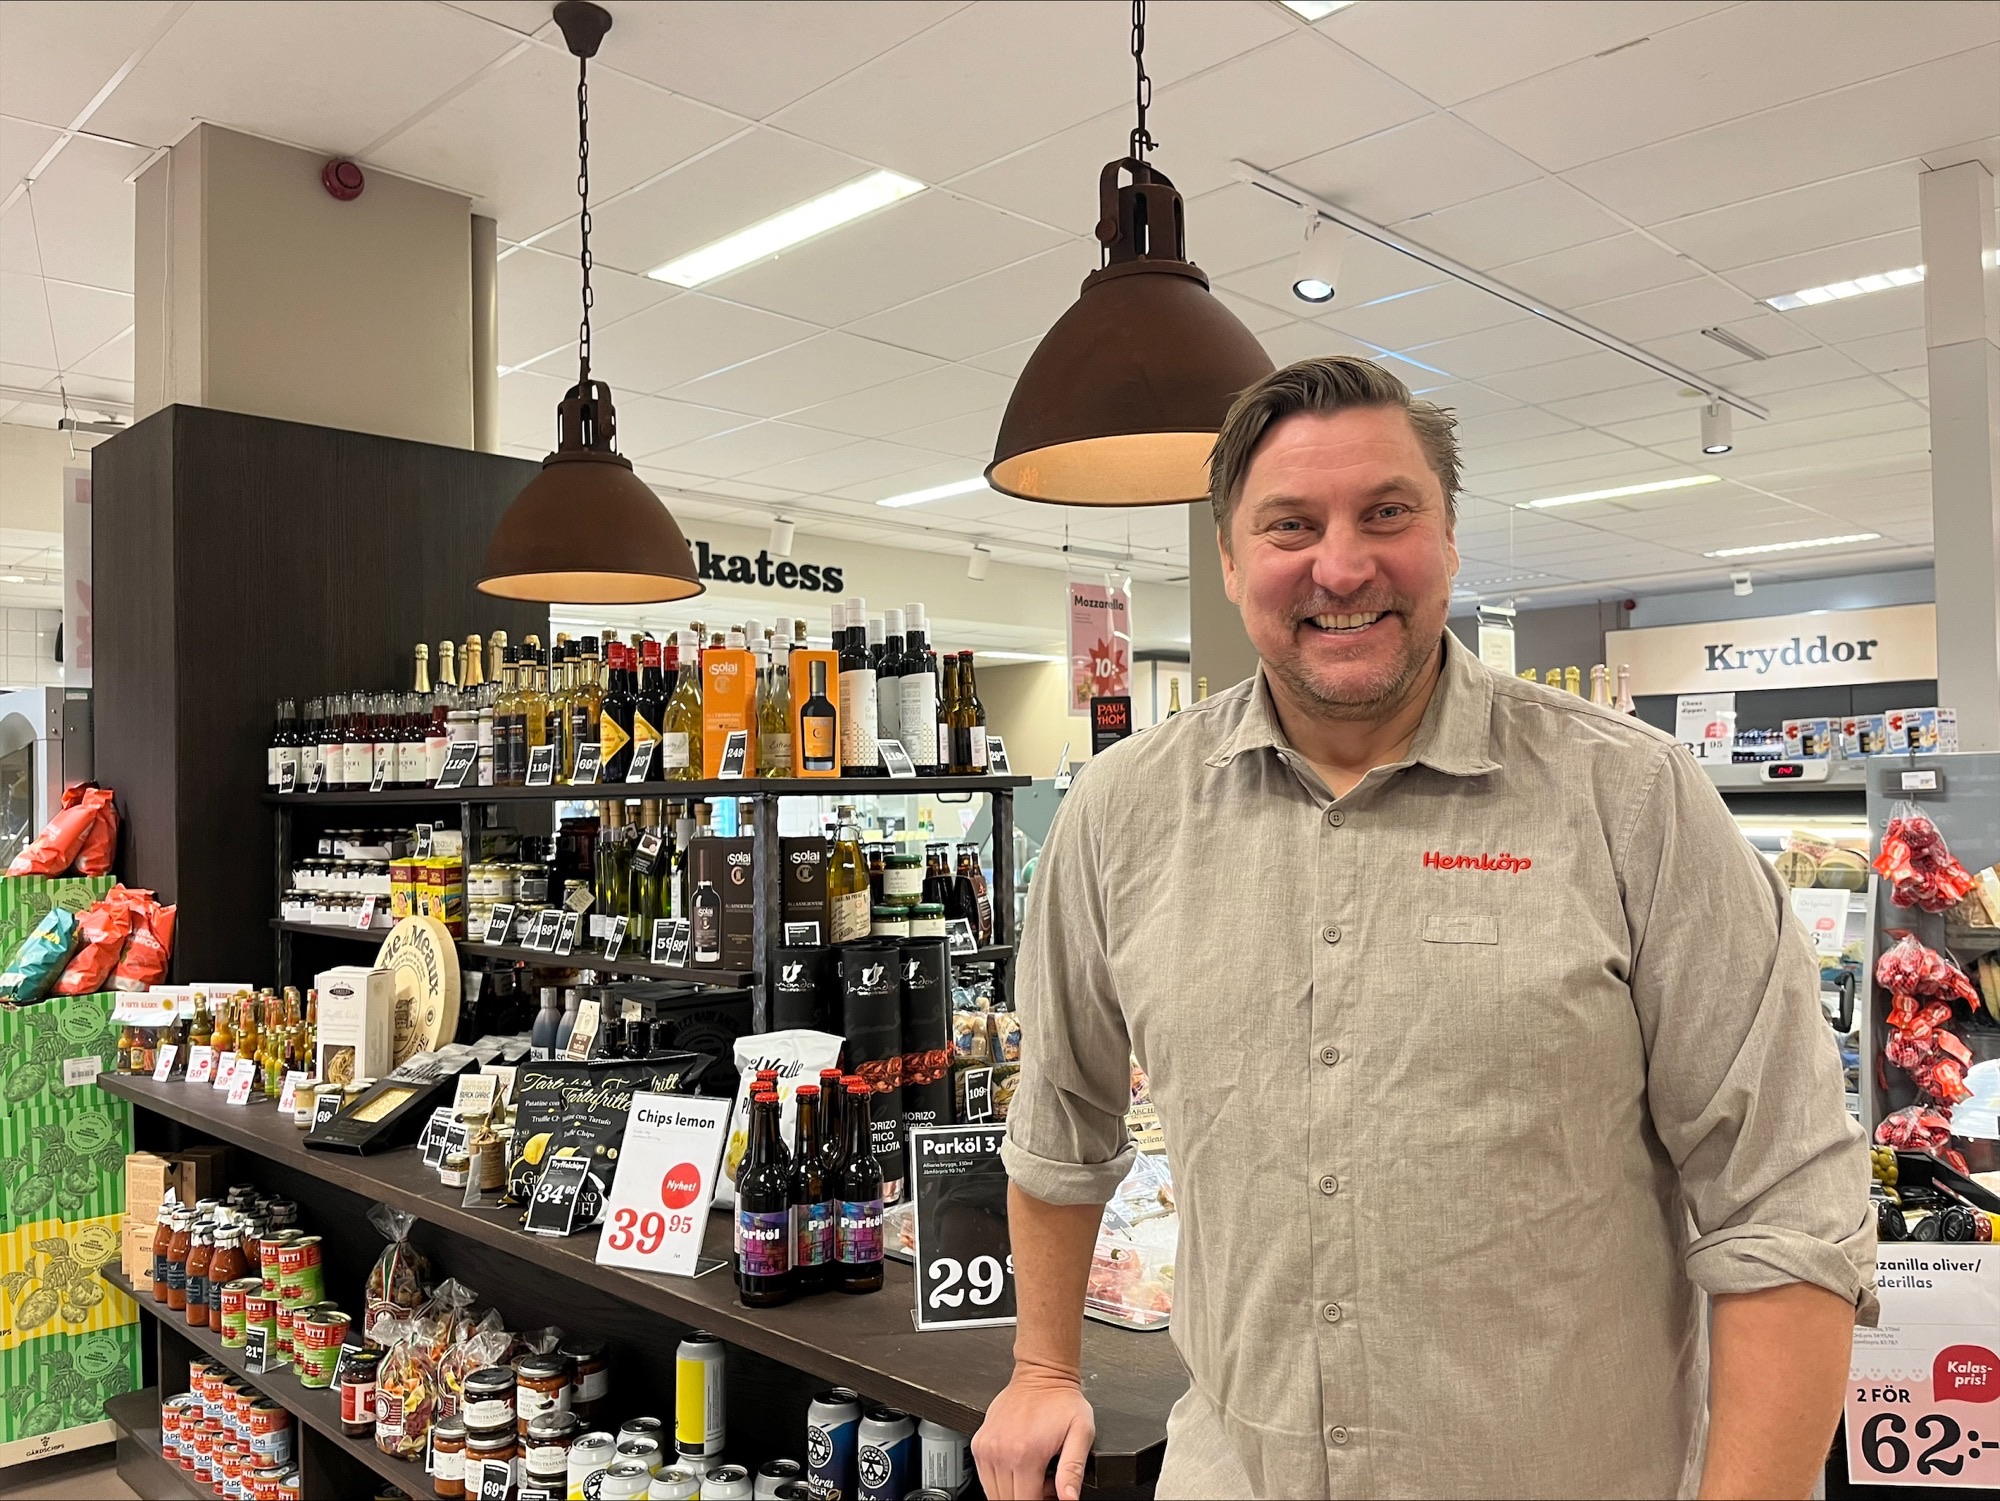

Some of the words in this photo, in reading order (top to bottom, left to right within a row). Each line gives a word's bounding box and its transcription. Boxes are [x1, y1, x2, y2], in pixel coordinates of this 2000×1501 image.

[688, 541, 844, 593] katess
[1074, 595, 1124, 611] Mozzarella
[1704, 635, 1878, 674] Kryddor
[1097, 703, 1126, 715] PAUL
[790, 850, 820, 864] Solai
[1423, 851, 1532, 873] Hemköp
[410, 924, 439, 999] Meaux
[764, 1056, 804, 1079] Valle
[637, 1108, 673, 1127] Chips
[675, 1111, 715, 1129] lemon
[922, 1136, 981, 1156] Parköl
[551, 1160, 585, 1171] Tryffelchips
[666, 1179, 697, 1192] Nyhet!
[840, 1213, 883, 1229] Parköl
[608, 1207, 666, 1255] 39
[668, 1214, 693, 1234] 95
[1932, 1257, 1982, 1273] oliver/
[928, 1254, 1004, 1310] 29
[1947, 1361, 1993, 1373] Kalas-
[1954, 1373, 1987, 1388] pris!
[1857, 1388, 1867, 1402] 2
[1871, 1384, 1911, 1403] FÖR
[26, 1443, 65, 1457] GÅRDSCHIPS
